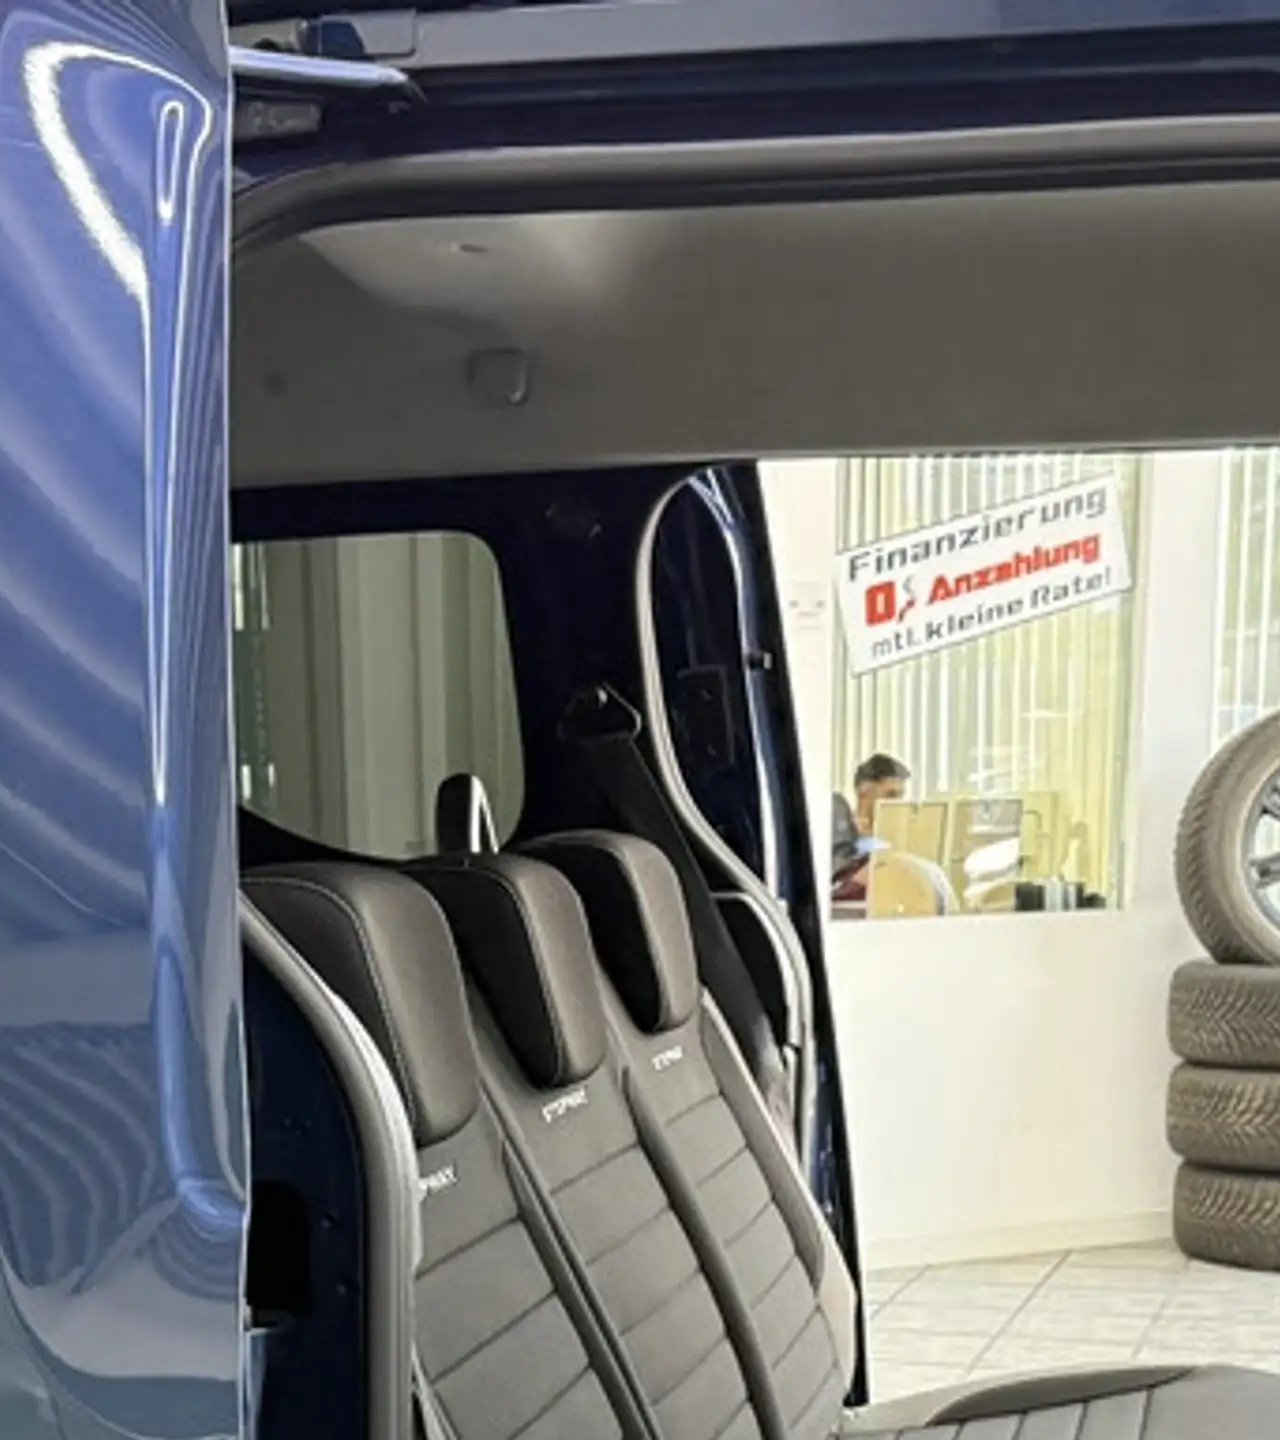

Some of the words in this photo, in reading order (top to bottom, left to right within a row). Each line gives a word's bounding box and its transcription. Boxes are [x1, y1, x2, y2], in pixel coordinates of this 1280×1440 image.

[849, 487, 1107, 581] Finanzierung
[926, 533, 1101, 606] Anzahlung
[925, 598, 1024, 643] kleine
